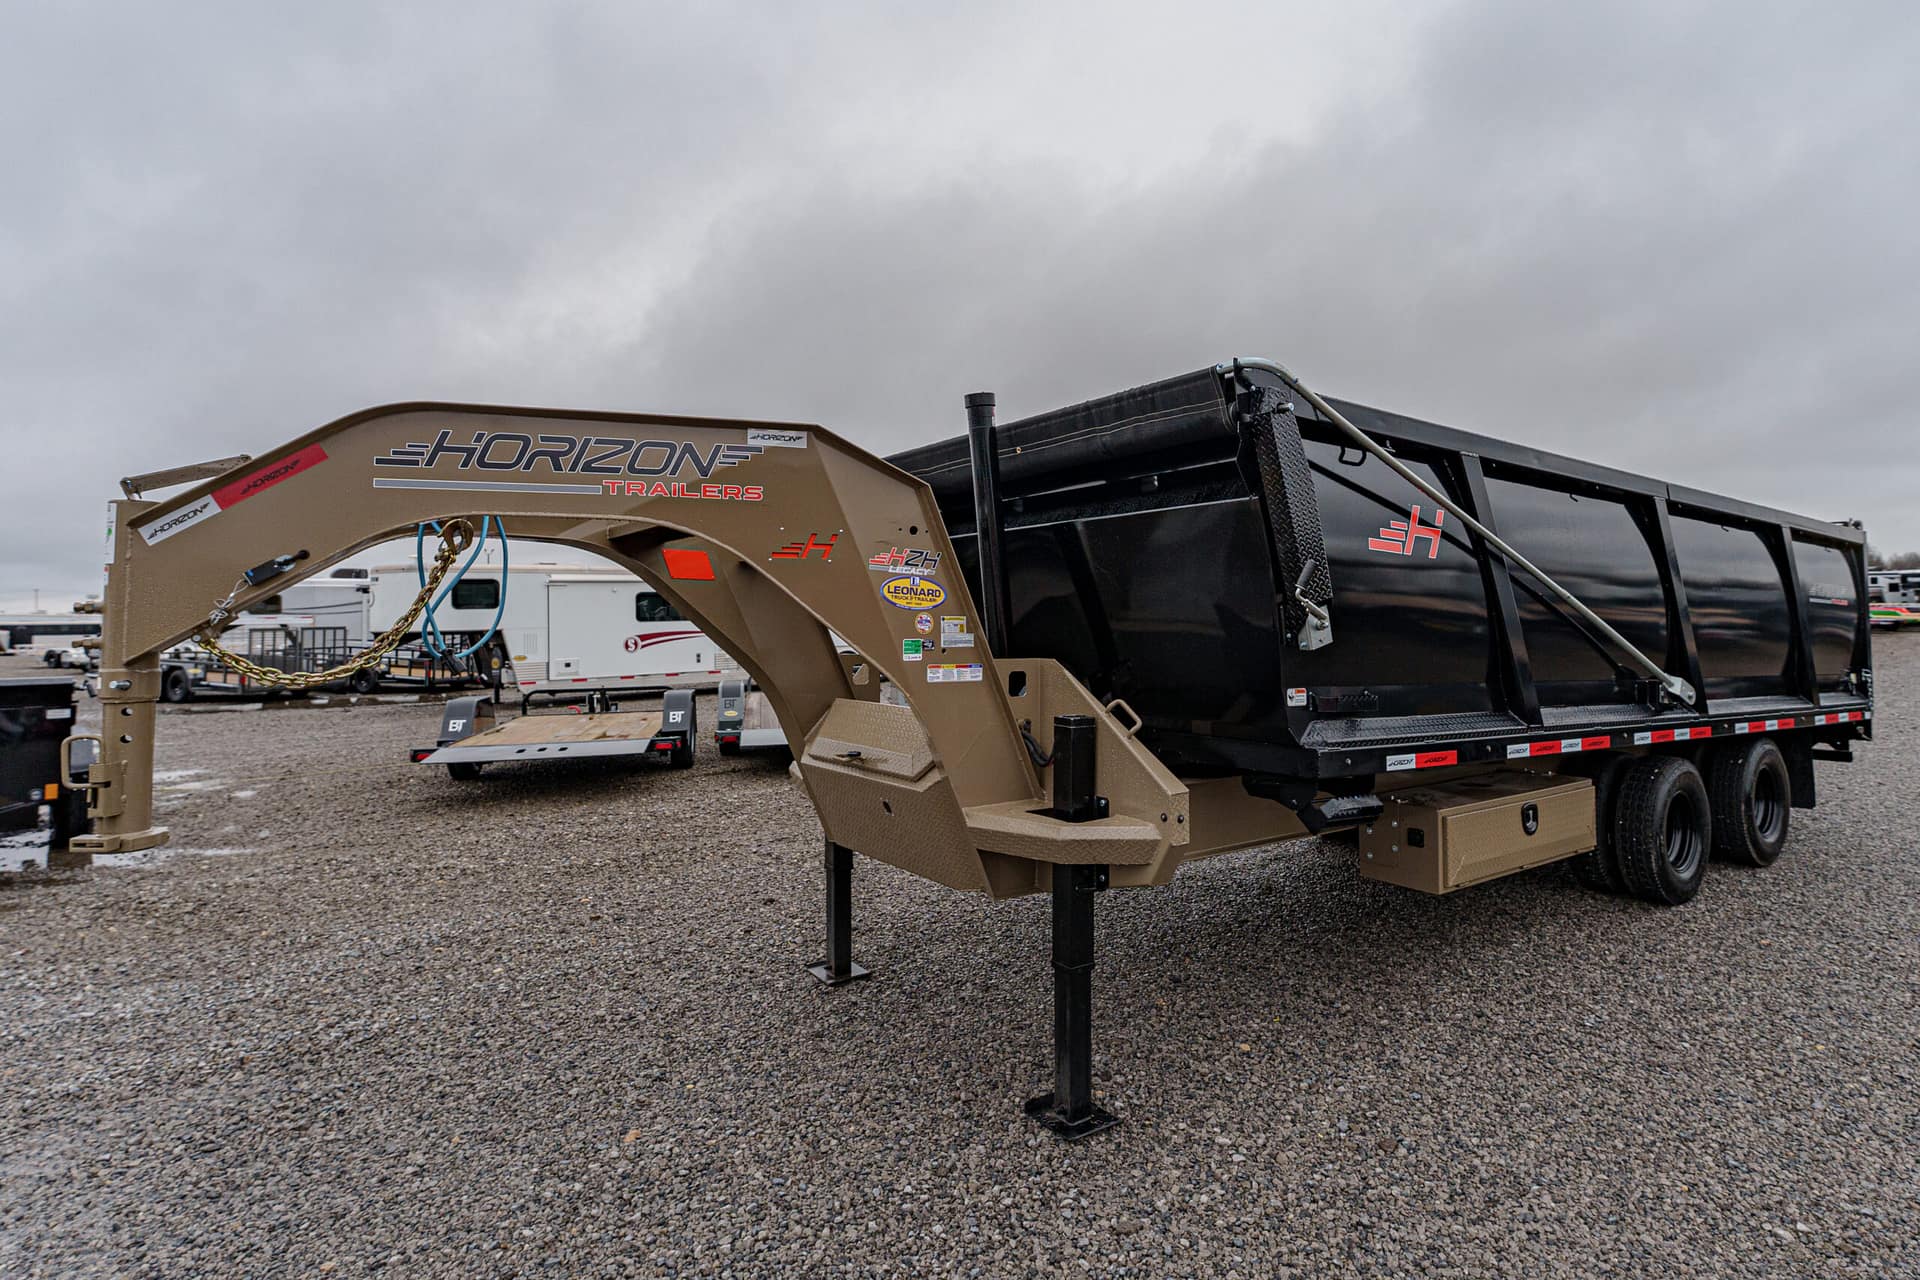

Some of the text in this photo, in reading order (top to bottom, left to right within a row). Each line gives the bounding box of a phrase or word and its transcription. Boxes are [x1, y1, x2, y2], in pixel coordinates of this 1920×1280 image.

[754, 432, 801, 442] HORIZON
[423, 429, 724, 479] HORIZON
[243, 462, 297, 493] HORIZON
[602, 479, 765, 502] TRAILERS
[150, 503, 207, 538] HORIZON
[887, 585, 942, 598] LEONARD
[448, 719, 467, 732] BT
[669, 711, 685, 724] BT
